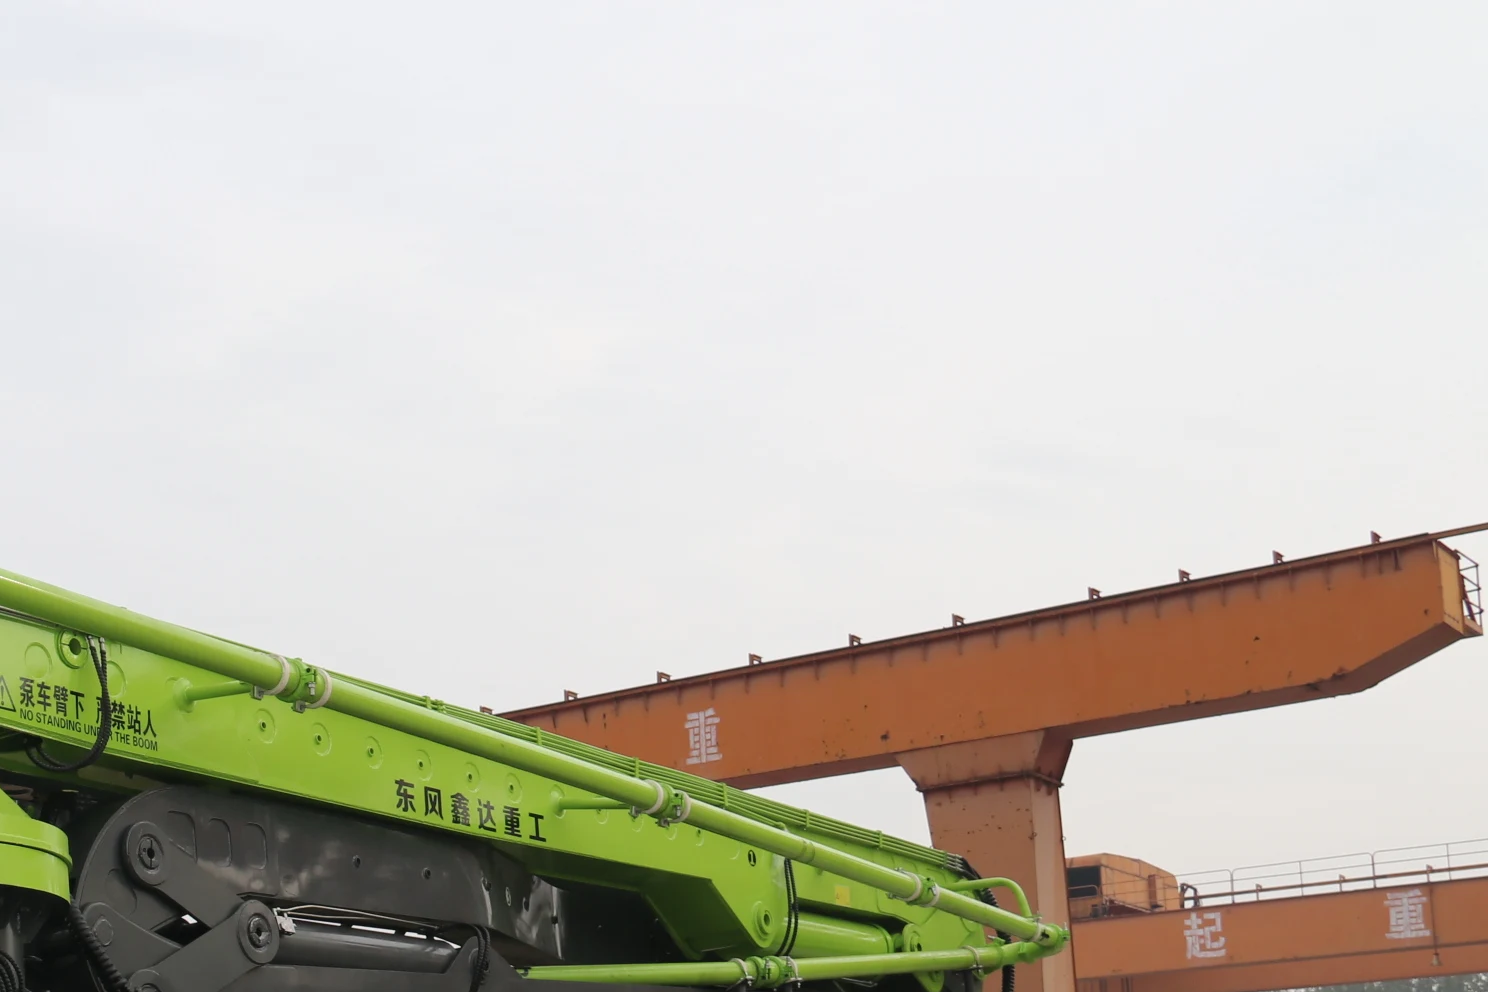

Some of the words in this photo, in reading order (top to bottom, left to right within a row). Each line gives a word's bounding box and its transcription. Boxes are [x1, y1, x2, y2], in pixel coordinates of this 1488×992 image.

[19, 677, 85, 720] 泵车臂下
[20, 709, 33, 721] NO
[36, 714, 81, 733] STANDING
[115, 732, 131, 745] THE
[133, 736, 158, 751] BOOM
[684, 707, 722, 765] 重
[394, 778, 547, 842] 东风鑫达重工
[1183, 911, 1226, 960] 起
[1383, 888, 1431, 940] 重
